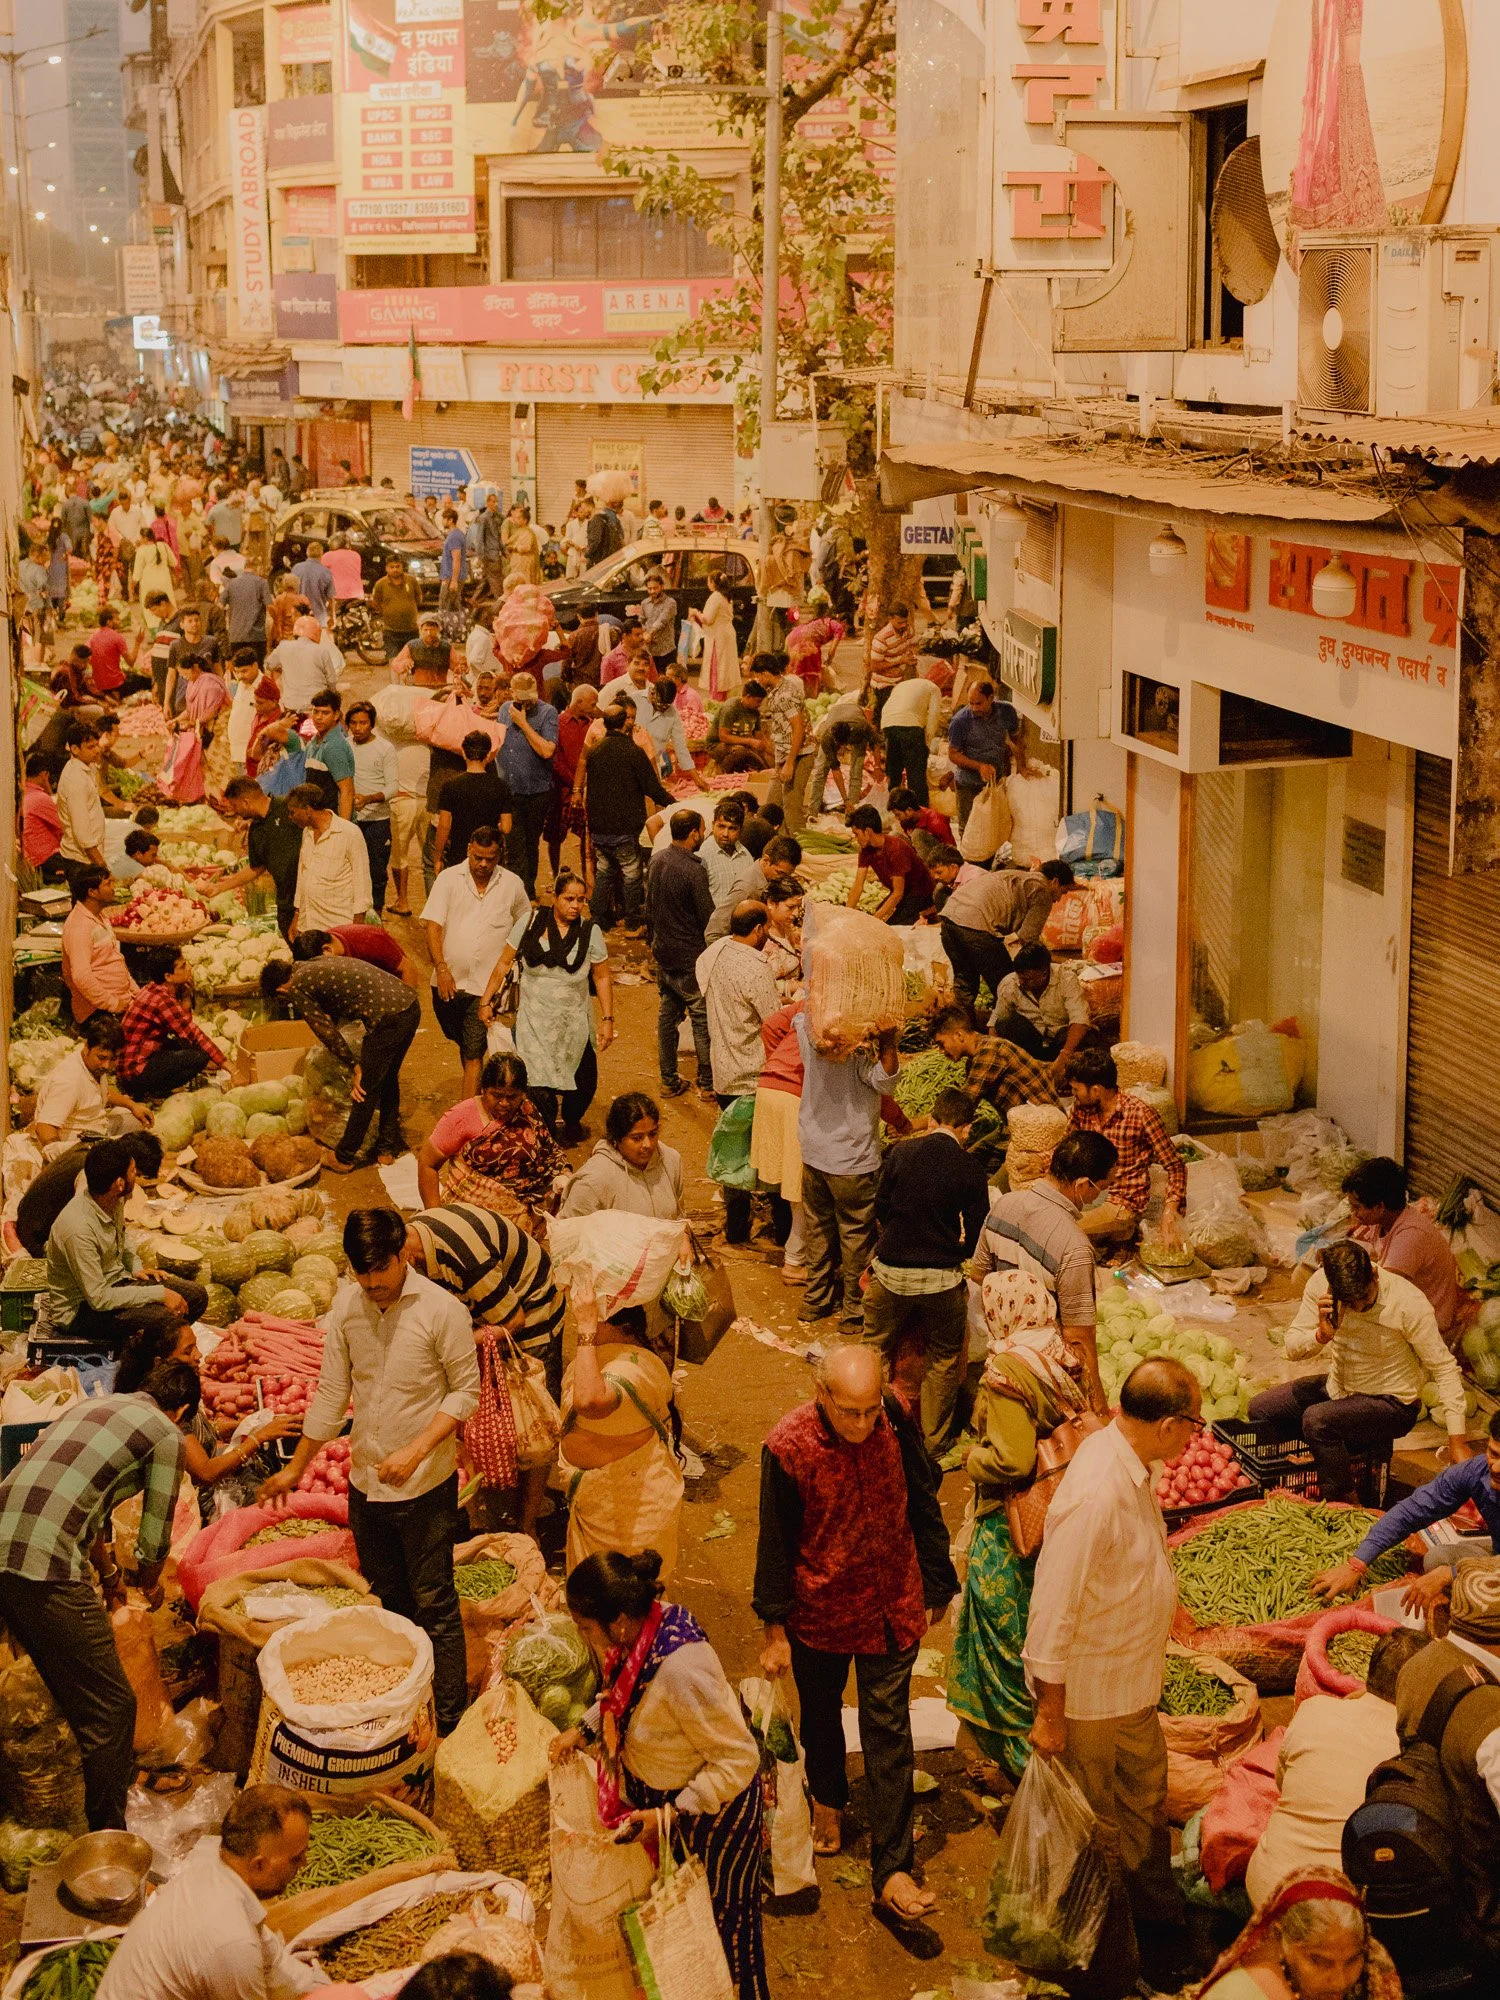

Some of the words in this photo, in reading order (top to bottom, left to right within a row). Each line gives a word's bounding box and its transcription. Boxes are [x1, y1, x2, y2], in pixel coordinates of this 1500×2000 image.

[407, 51, 454, 77] इंडिया
[367, 110, 395, 121] UPSC
[367, 132, 397, 143] BANK
[421, 129, 443, 141] SSC
[239, 112, 259, 210] ABROAD
[420, 174, 444, 187] LAW
[243, 215, 263, 292] STUDY
[369, 306, 437, 323] GAMING
[609, 293, 685, 310] ARENA
[498, 363, 600, 393] FIRST
[1397, 655, 1433, 684] पदार्थ
[1437, 666, 1448, 688] व
[274, 1730, 325, 1770] PREMIUM
[327, 1744, 401, 1773] GROUNDNUT
[278, 1763, 333, 1795] INSHELL
